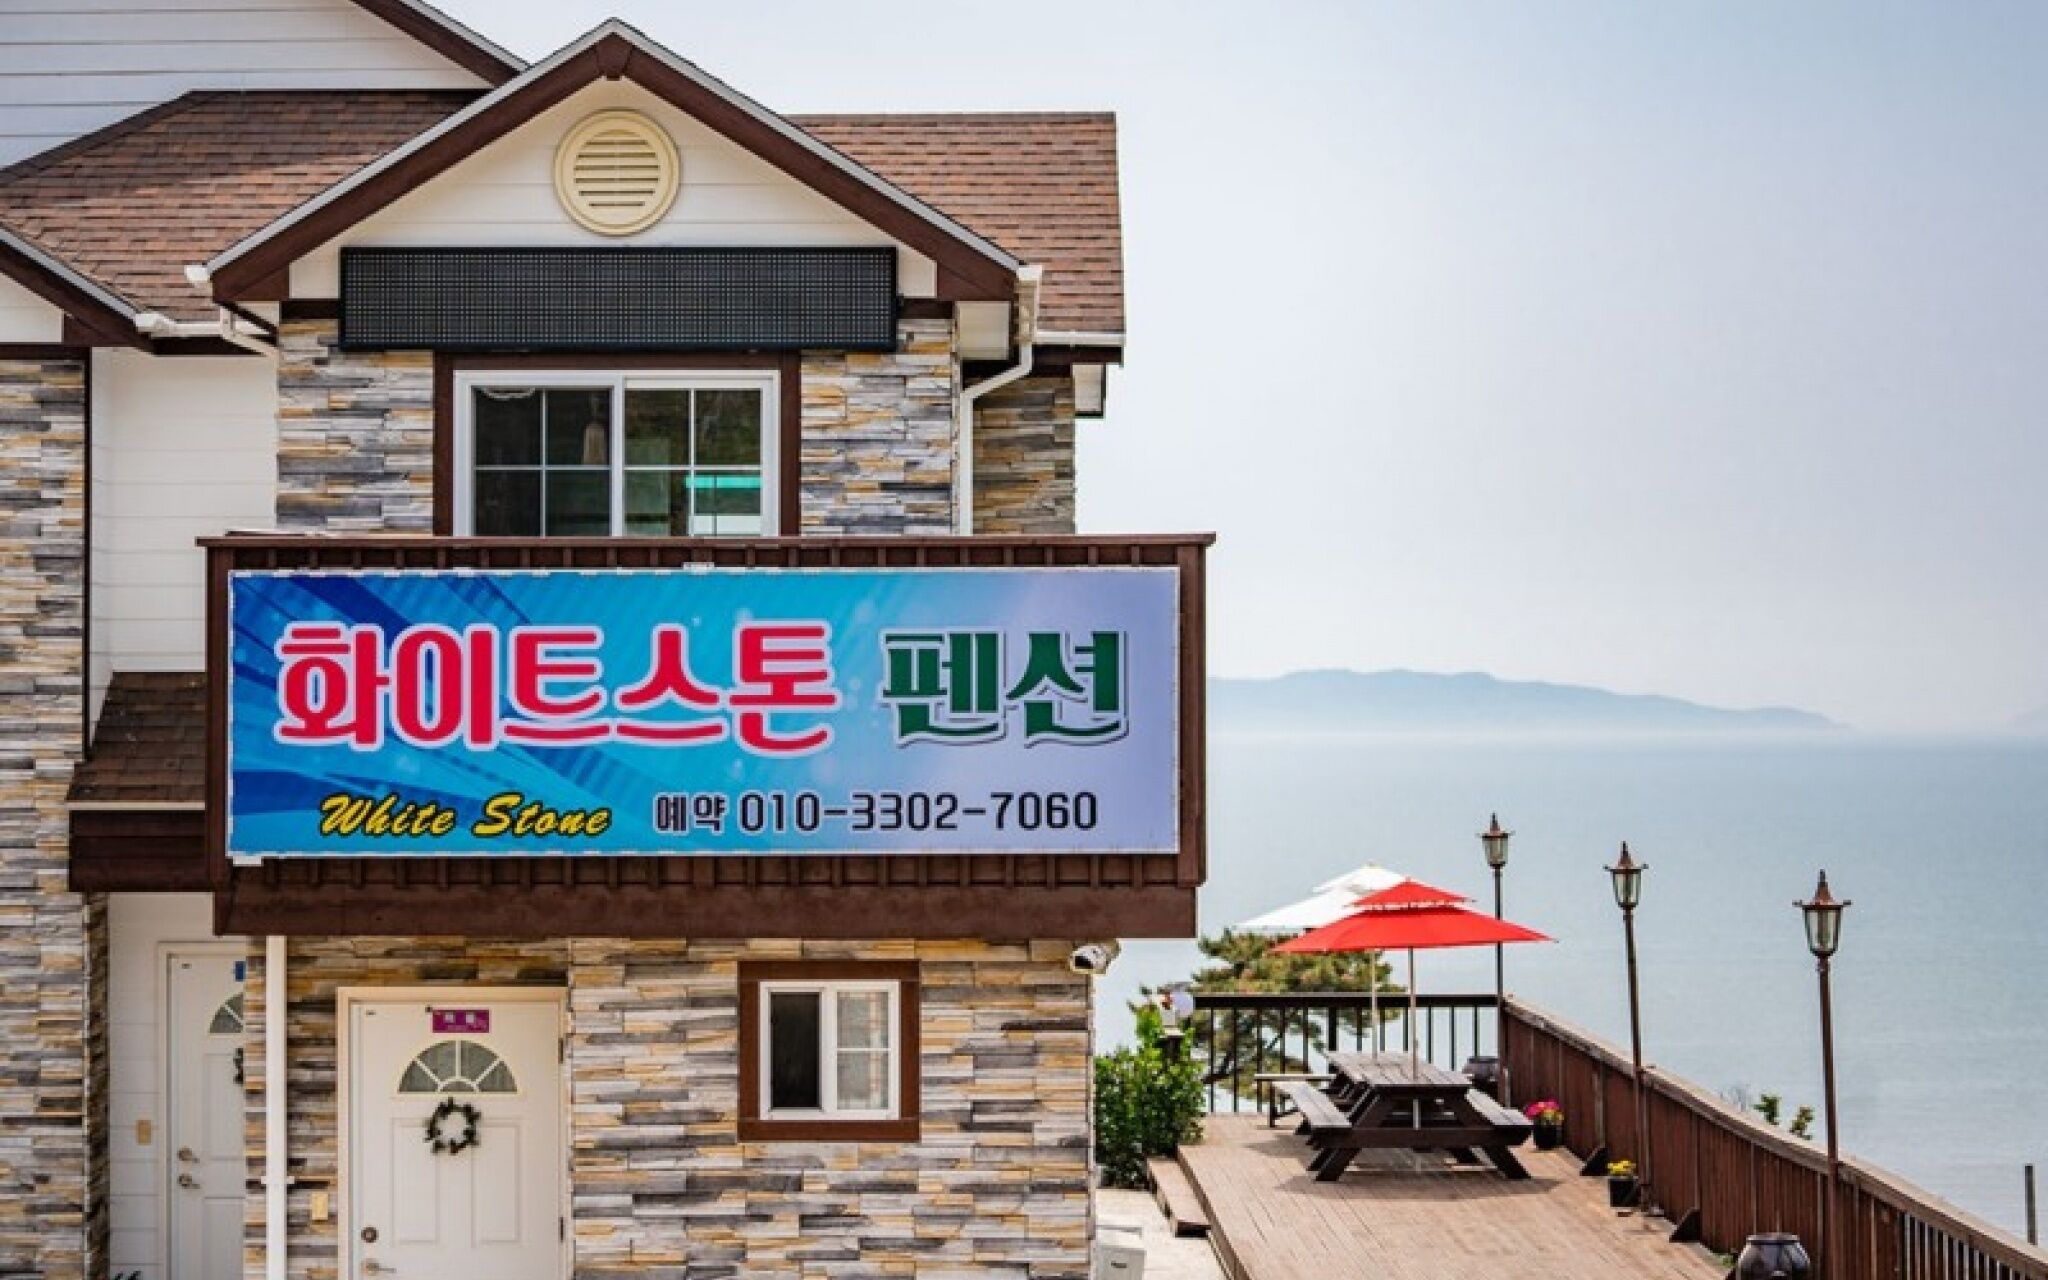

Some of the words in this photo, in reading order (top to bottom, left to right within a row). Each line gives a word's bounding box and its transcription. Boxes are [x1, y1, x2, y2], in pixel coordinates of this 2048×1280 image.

[275, 622, 839, 755] 화이트스톤
[881, 630, 1127, 747] 펜션
[319, 794, 456, 837] White
[473, 792, 612, 837] Stone
[654, 793, 726, 834] 예약
[739, 791, 1098, 833] 010-3302-7060
